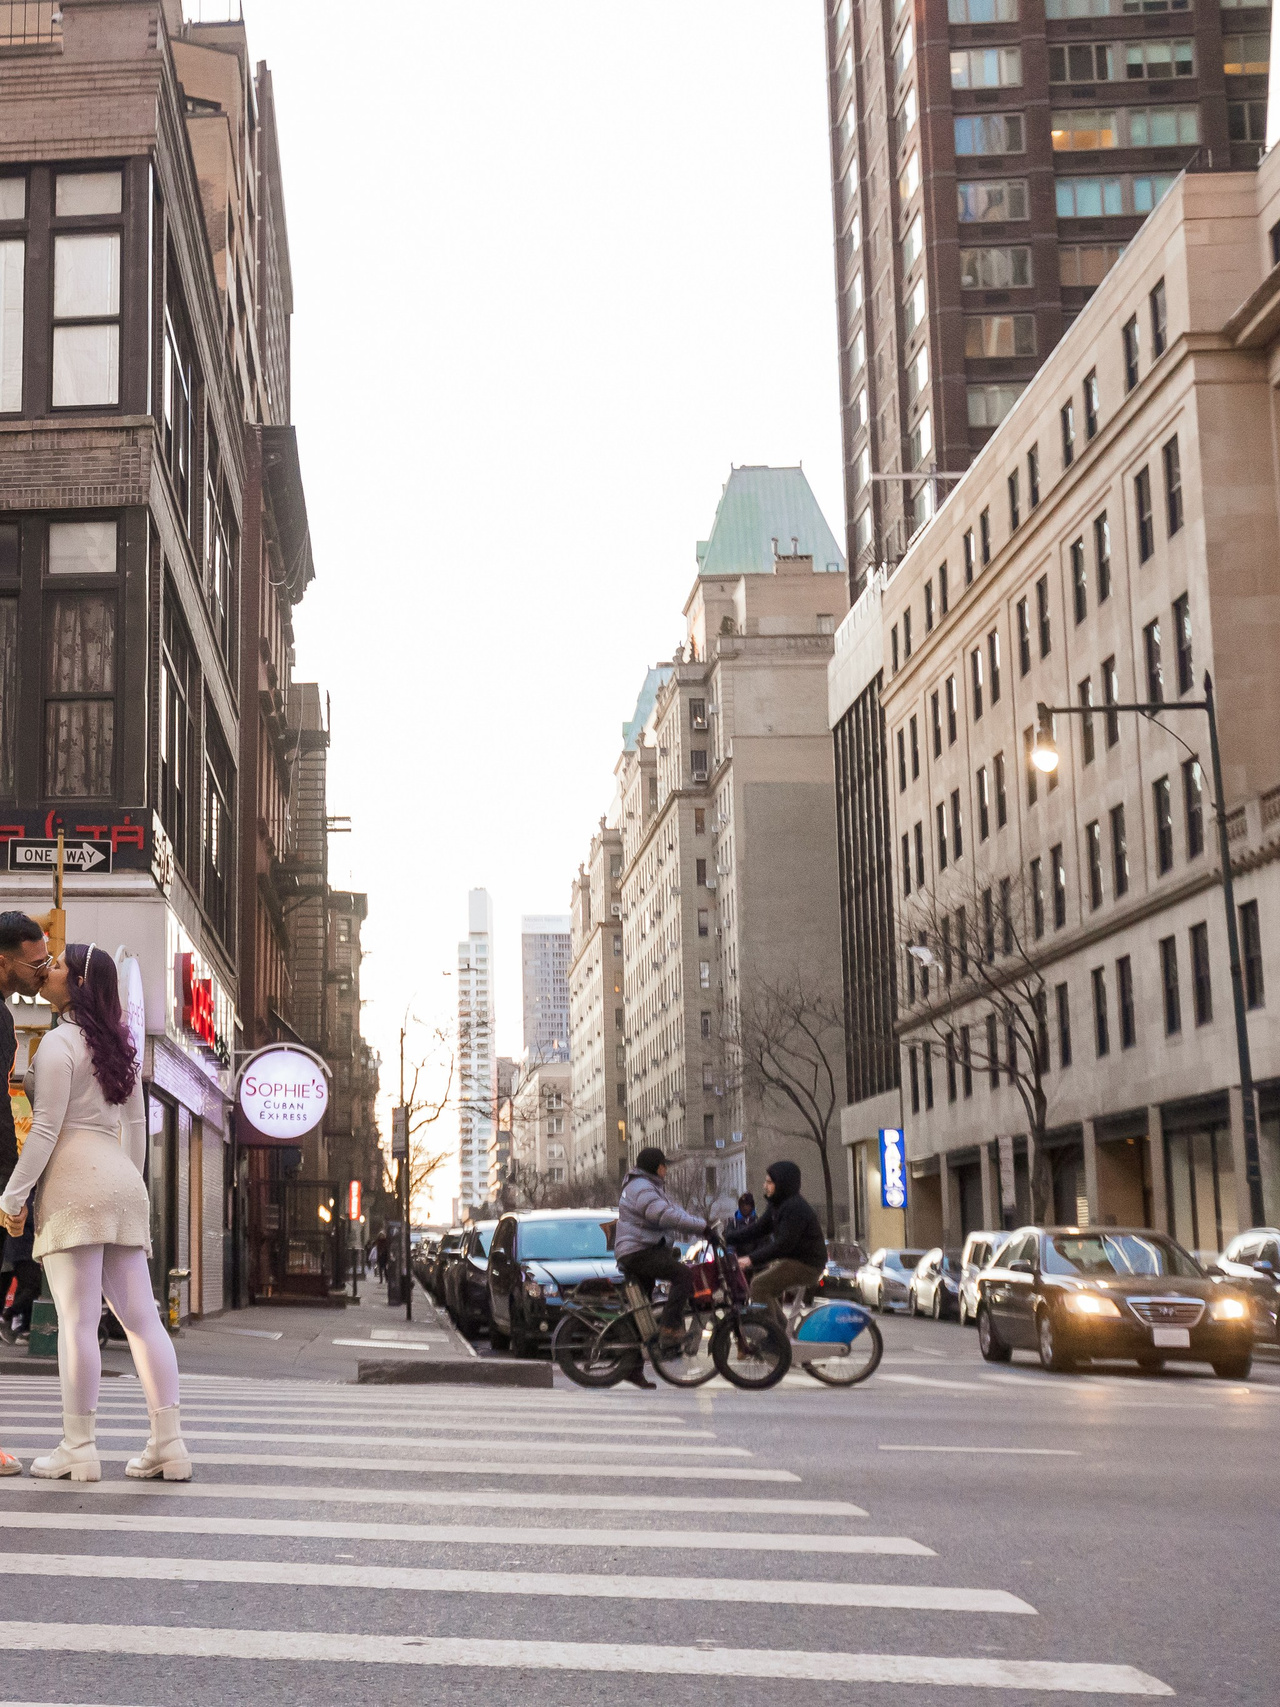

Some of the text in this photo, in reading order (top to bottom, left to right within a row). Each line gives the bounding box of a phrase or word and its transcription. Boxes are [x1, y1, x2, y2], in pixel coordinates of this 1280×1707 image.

[24, 848, 97, 864] ONE WAY
[245, 1076, 325, 1100] SOPHIE'S
[263, 1099, 305, 1111] CUBAN
